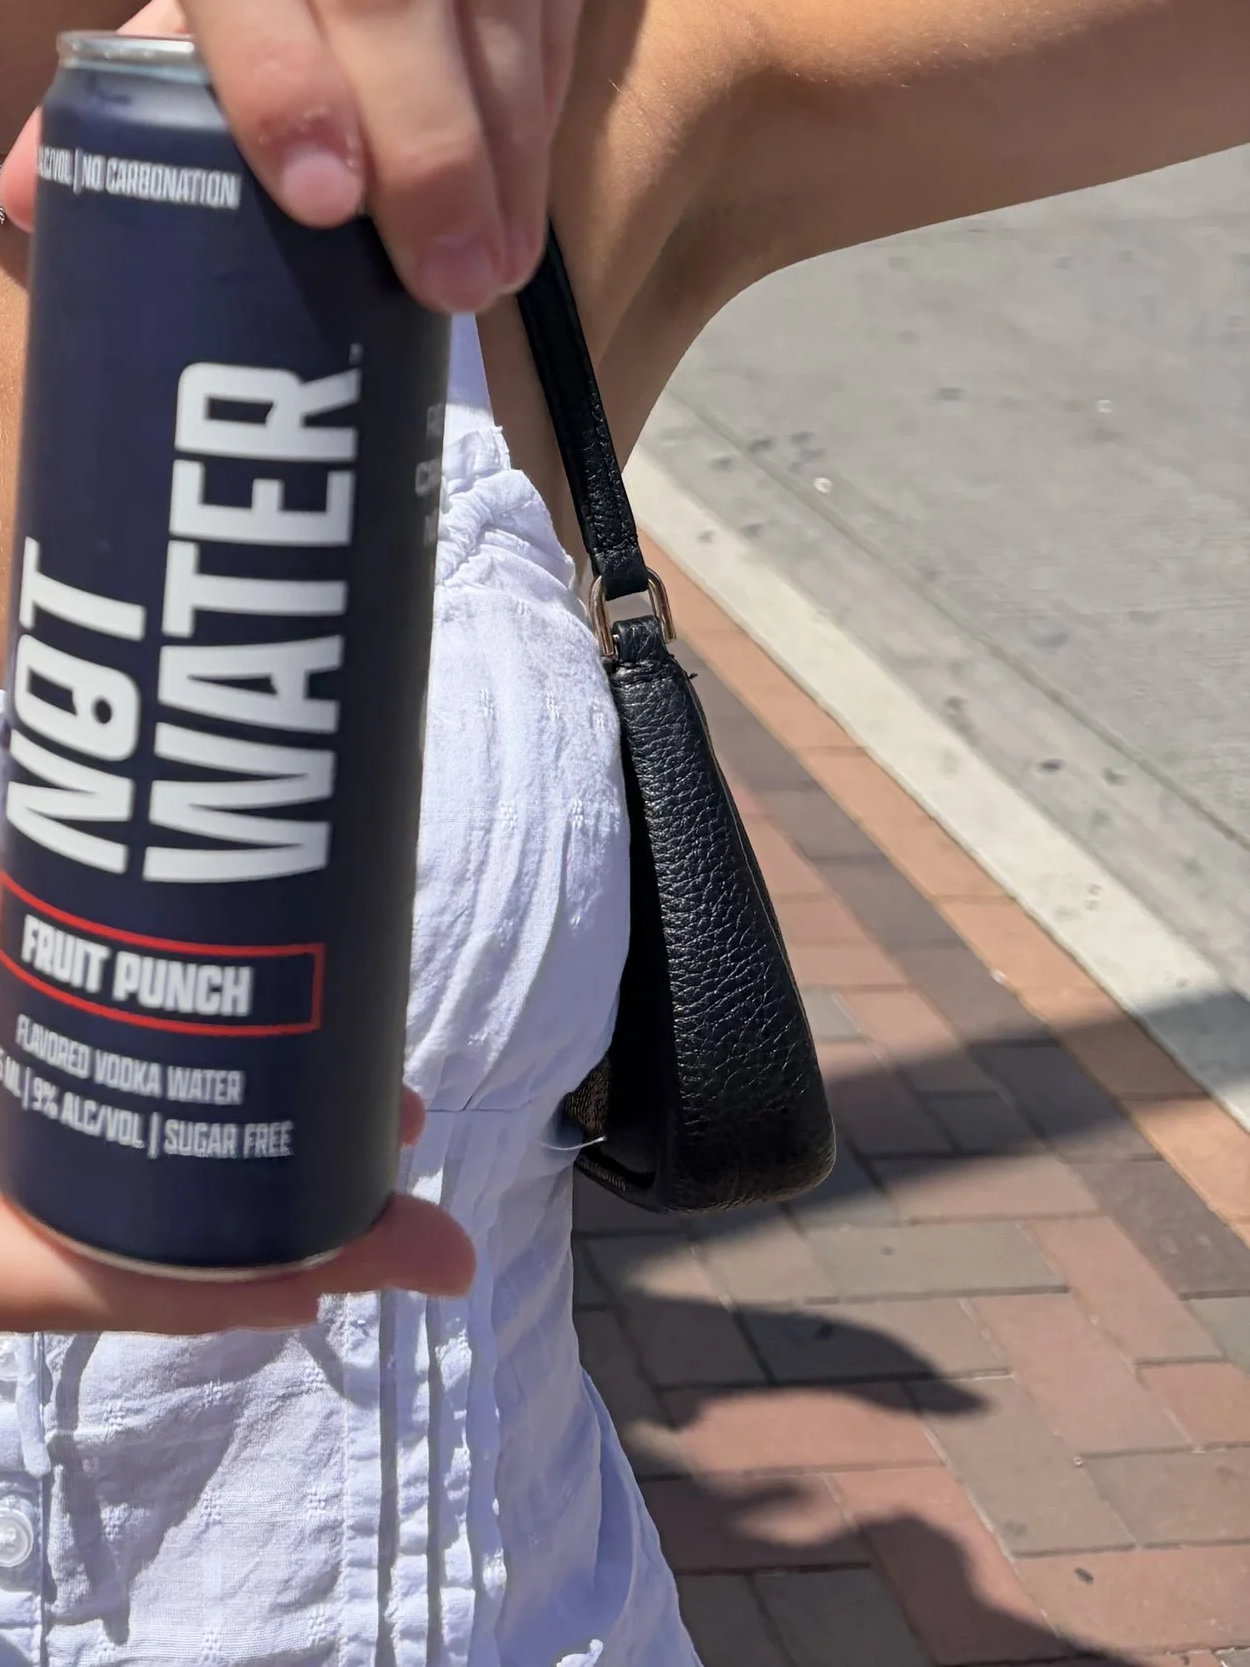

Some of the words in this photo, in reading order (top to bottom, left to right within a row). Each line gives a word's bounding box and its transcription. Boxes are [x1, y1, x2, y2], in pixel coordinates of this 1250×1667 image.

[82, 152, 106, 192] NO
[106, 157, 243, 210] CARBONATION
[143, 361, 362, 883] WATER
[21, 913, 111, 993] FRUIT
[112, 950, 255, 1017] PUNCH
[15, 1013, 91, 1080] FLAVORED
[94, 1049, 162, 1098] VODKA
[166, 1065, 246, 1106] WATER
[60, 1091, 145, 1149] ALC/VOL
[163, 1119, 241, 1159] SUGAR
[243, 1120, 295, 1159] FREE
